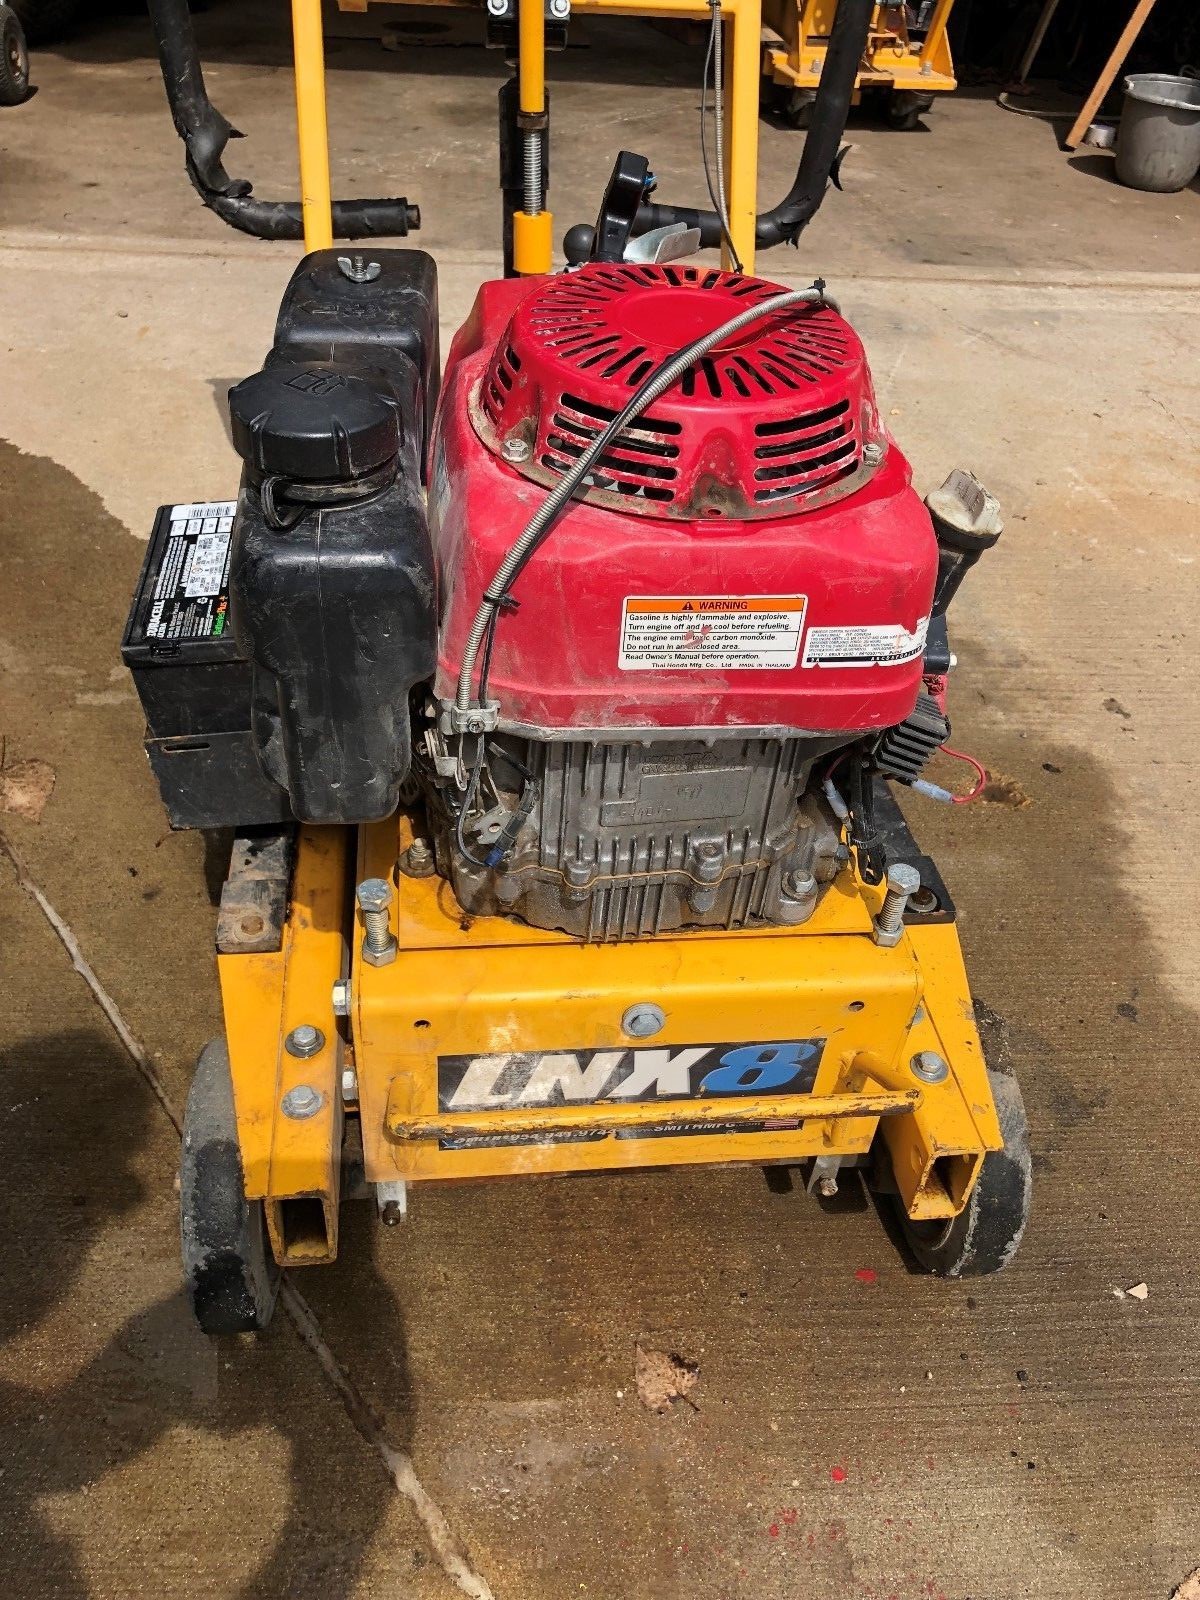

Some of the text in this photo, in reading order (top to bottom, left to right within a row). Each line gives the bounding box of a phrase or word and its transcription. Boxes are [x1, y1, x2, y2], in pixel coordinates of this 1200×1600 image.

[699, 601, 748, 610] WARNING
[146, 599, 166, 637] DURACELL
[629, 613, 661, 621] Gasoline
[671, 613, 694, 622] highly
[695, 613, 736, 621] flammable
[753, 613, 790, 622] explosive.
[646, 623, 672, 632] engine
[757, 622, 792, 632] refueling.
[643, 634, 668, 642] engine
[739, 633, 777, 641] monoxide.
[725, 653, 760, 661] operation.
